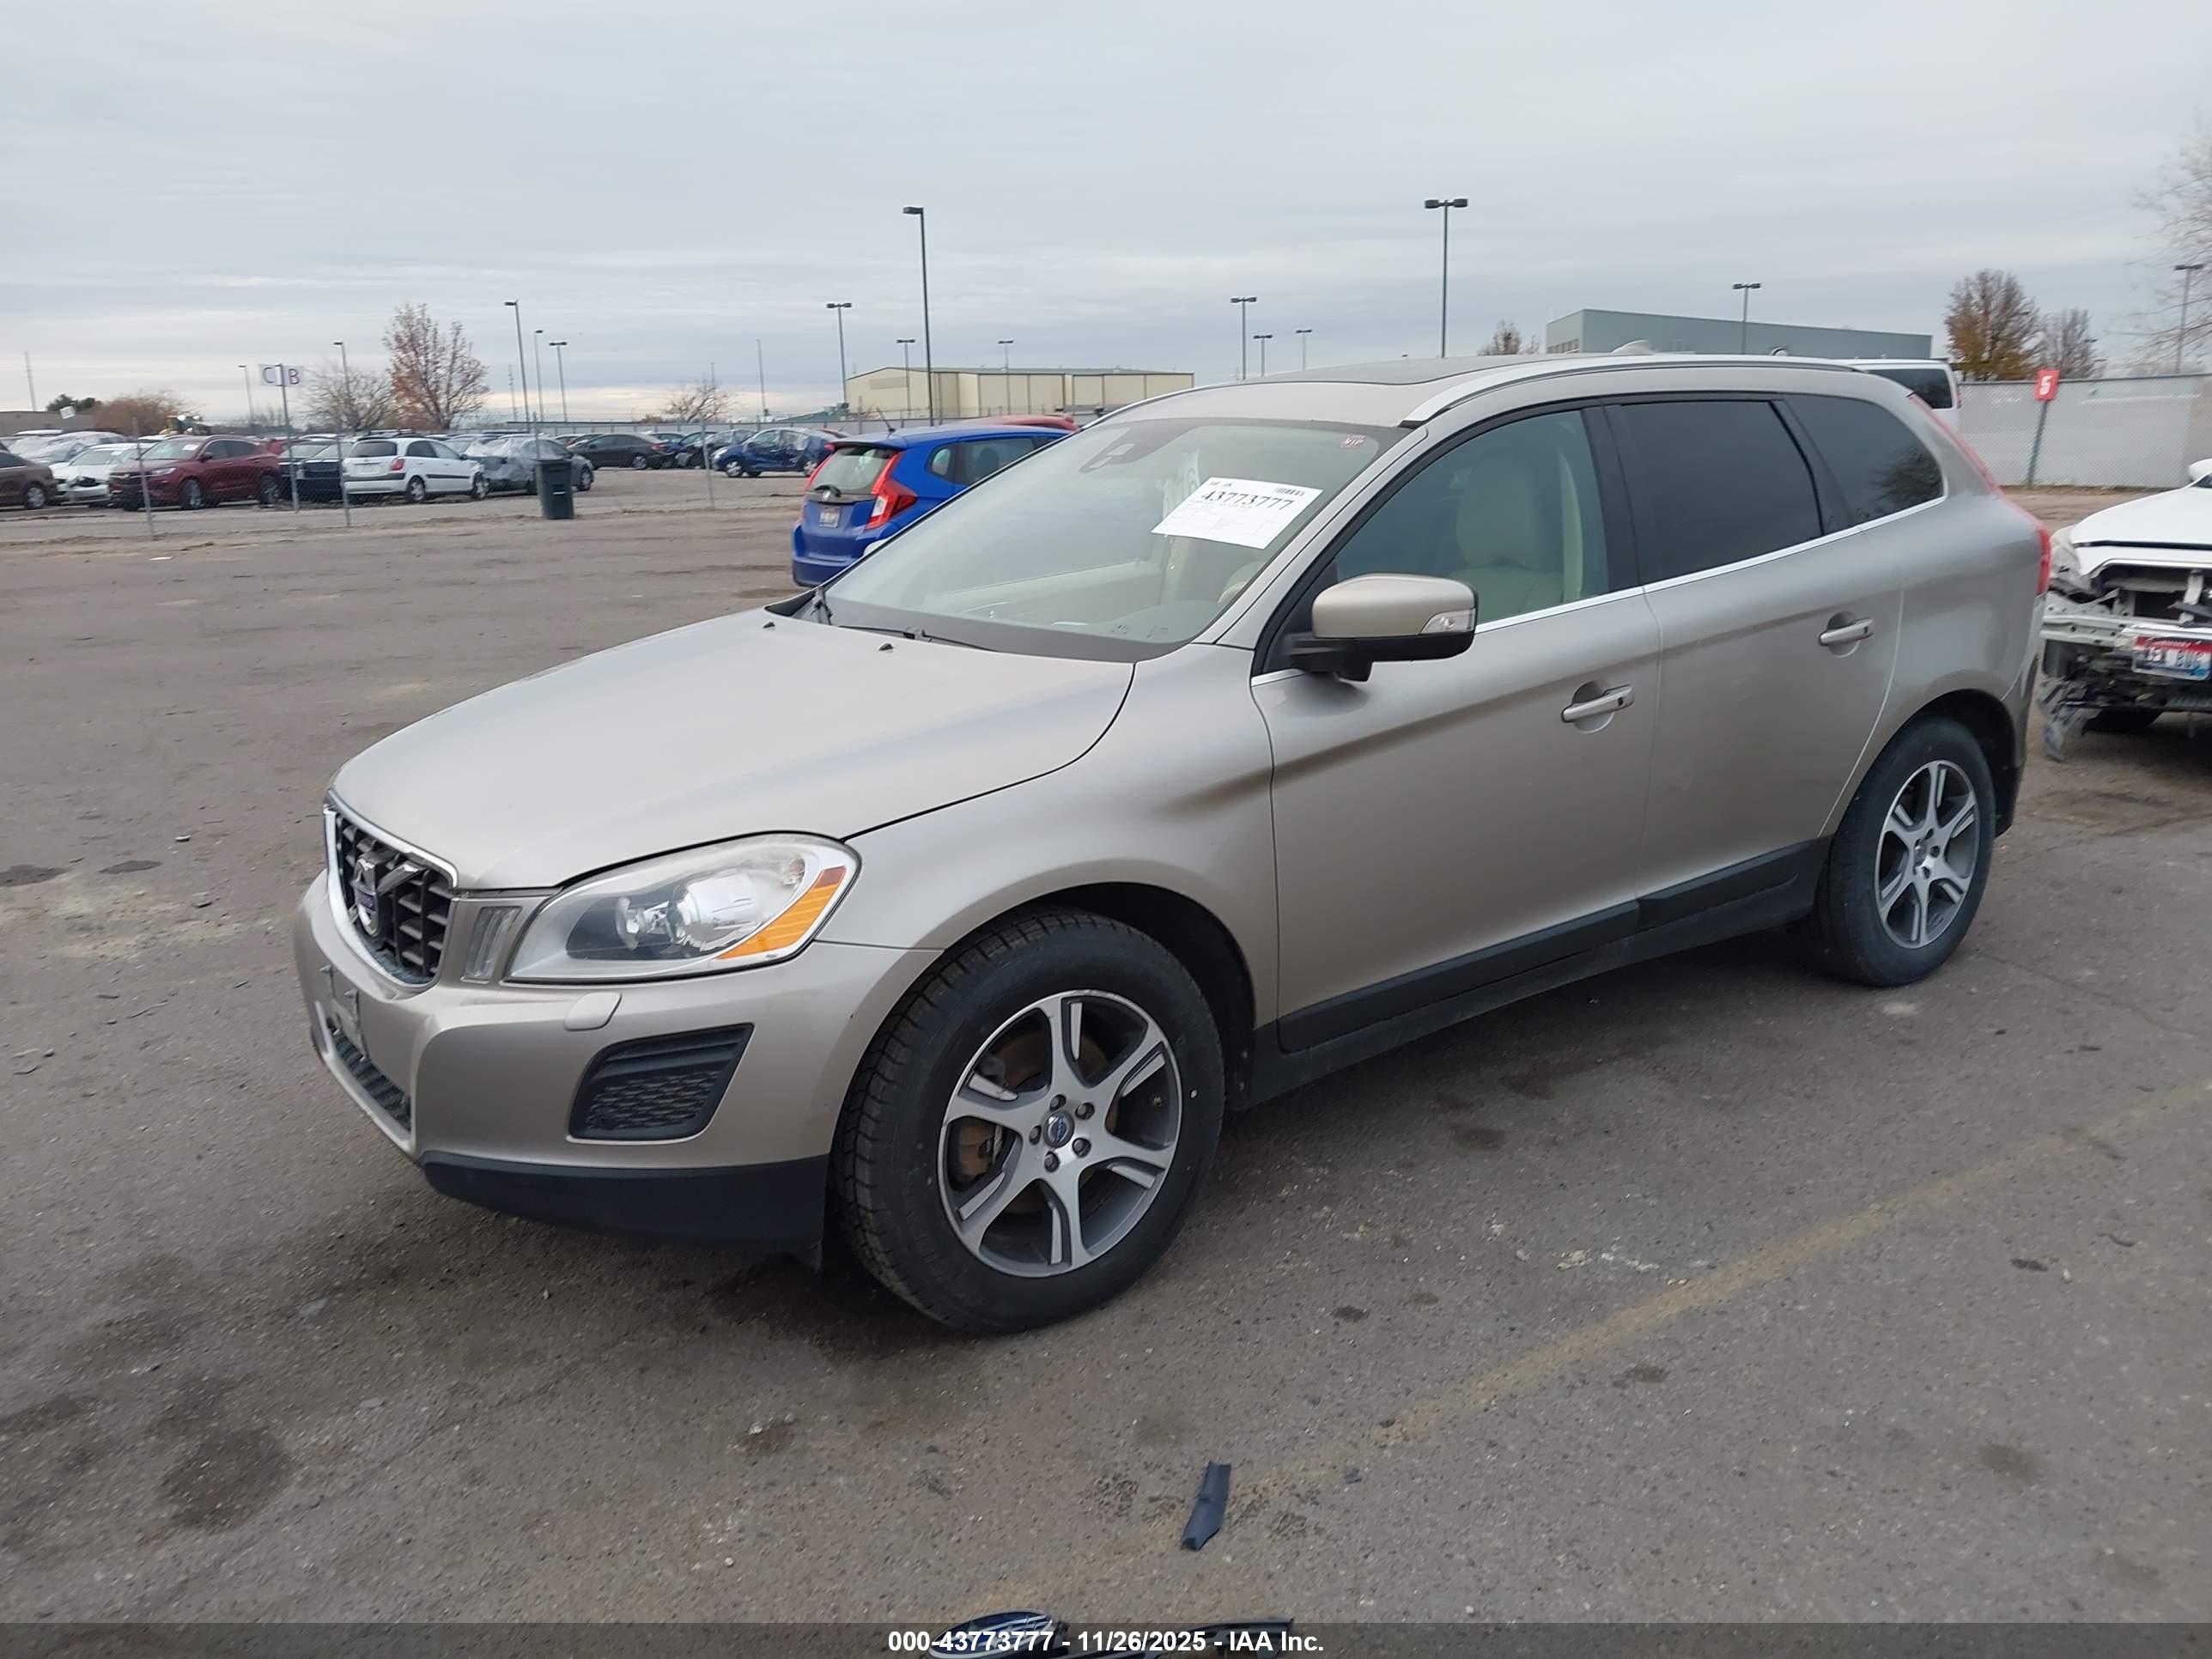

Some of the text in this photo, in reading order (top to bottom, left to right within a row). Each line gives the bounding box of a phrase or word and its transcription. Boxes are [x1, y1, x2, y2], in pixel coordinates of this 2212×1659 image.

[262, 367, 274, 384] C
[289, 368, 301, 385] B
[1201, 490, 1296, 511] 43773777
